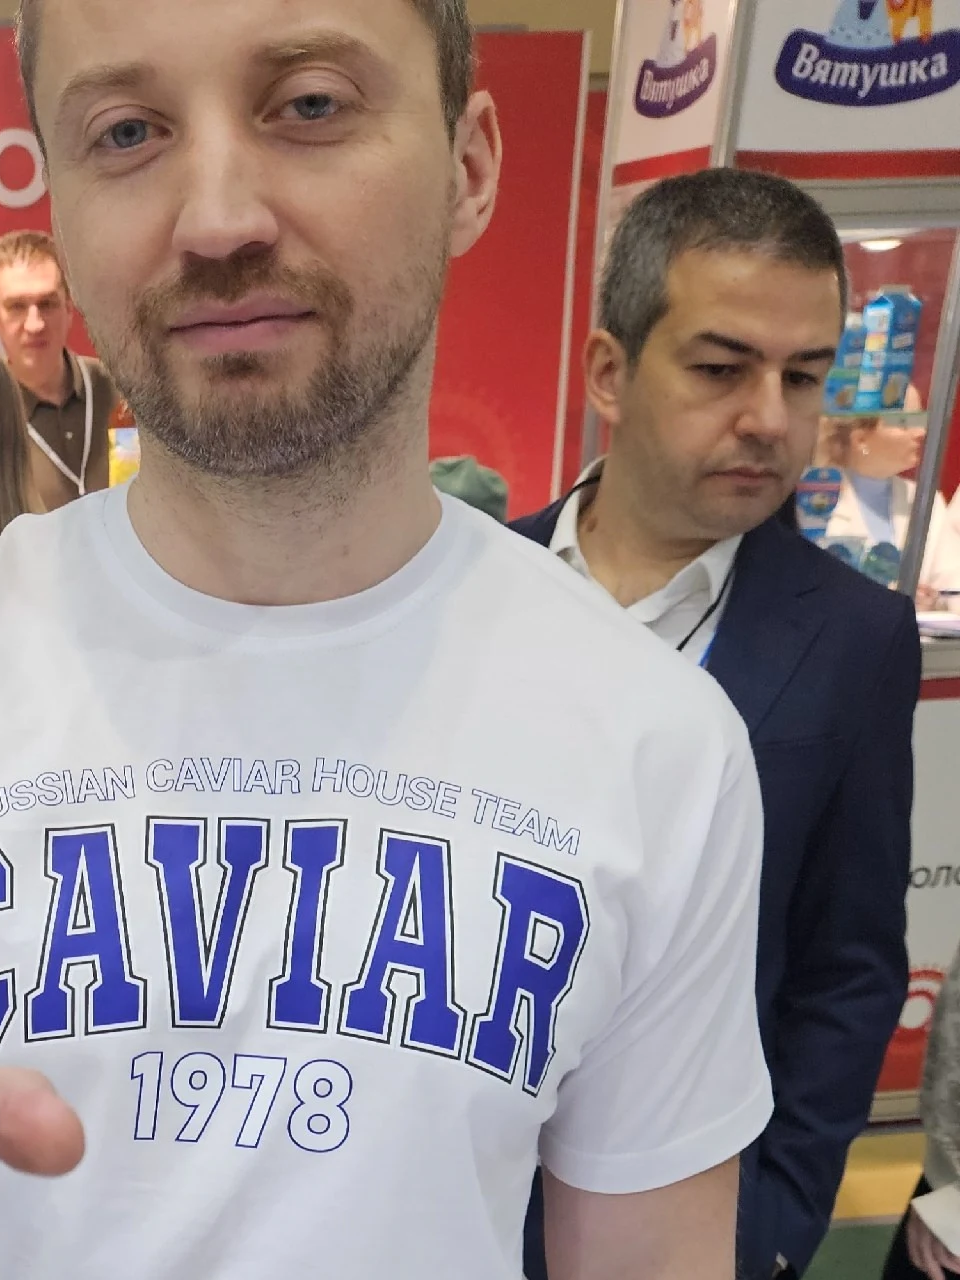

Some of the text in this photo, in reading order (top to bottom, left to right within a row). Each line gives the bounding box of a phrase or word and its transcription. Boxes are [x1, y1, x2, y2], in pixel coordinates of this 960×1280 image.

[791, 43, 949, 98] Вятушка
[145, 757, 302, 794] CAVIAR
[311, 757, 462, 818] HOUSE
[471, 788, 581, 856] TEAM
[130, 1051, 353, 1153] 1978
